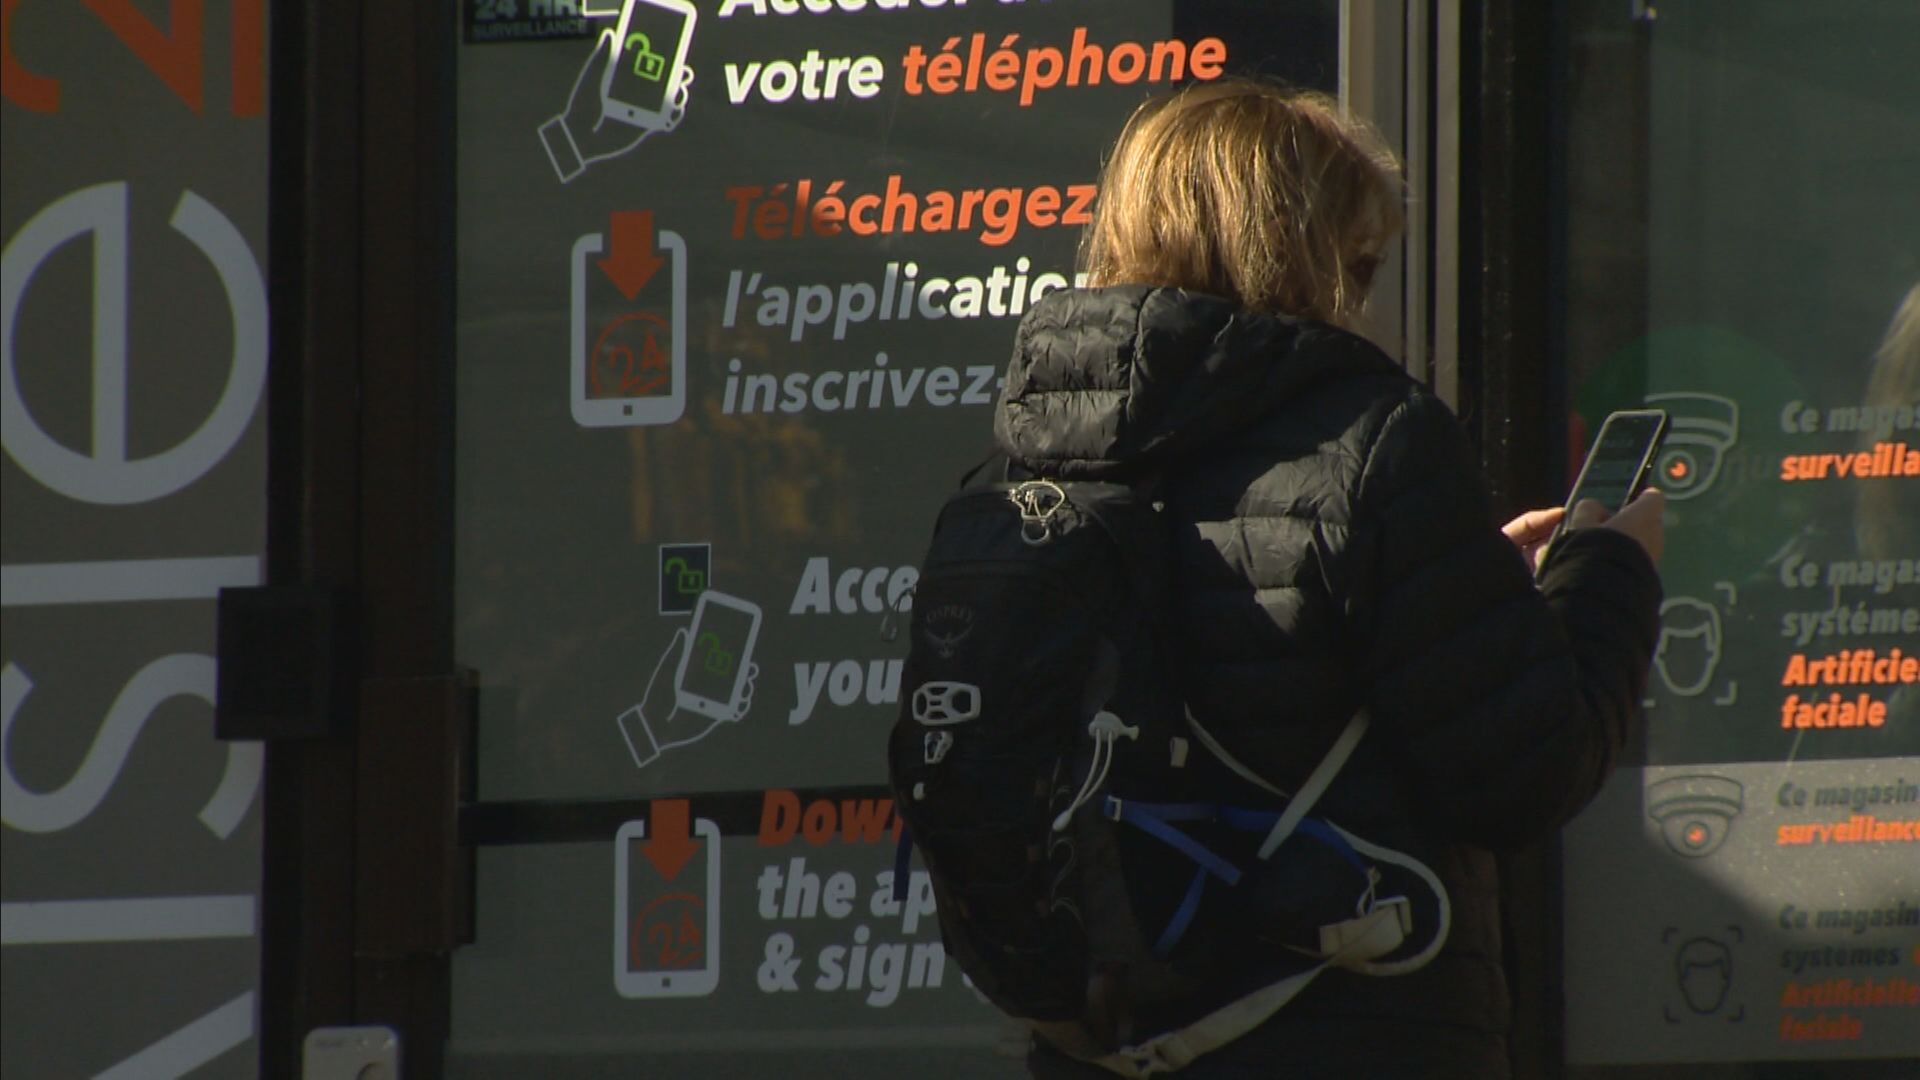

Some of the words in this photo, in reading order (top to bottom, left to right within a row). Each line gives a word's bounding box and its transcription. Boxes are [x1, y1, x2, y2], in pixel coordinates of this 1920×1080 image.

[473, 19, 587, 38] SURVEILLANCE
[724, 50, 884, 105] votre
[902, 27, 1227, 106] téléphone
[724, 174, 1099, 247] Téléchargez
[1781, 400, 1820, 433] Ce
[789, 556, 920, 615] Acce
[1780, 553, 1819, 588] Ce
[1780, 601, 1920, 646] systéme
[1780, 647, 1920, 687] Artificie
[788, 659, 904, 726] you
[1780, 692, 1887, 730] faciale
[1777, 782, 1807, 807] Ce
[757, 857, 857, 919] the
[757, 932, 801, 993] &
[814, 924, 946, 1007] sign
